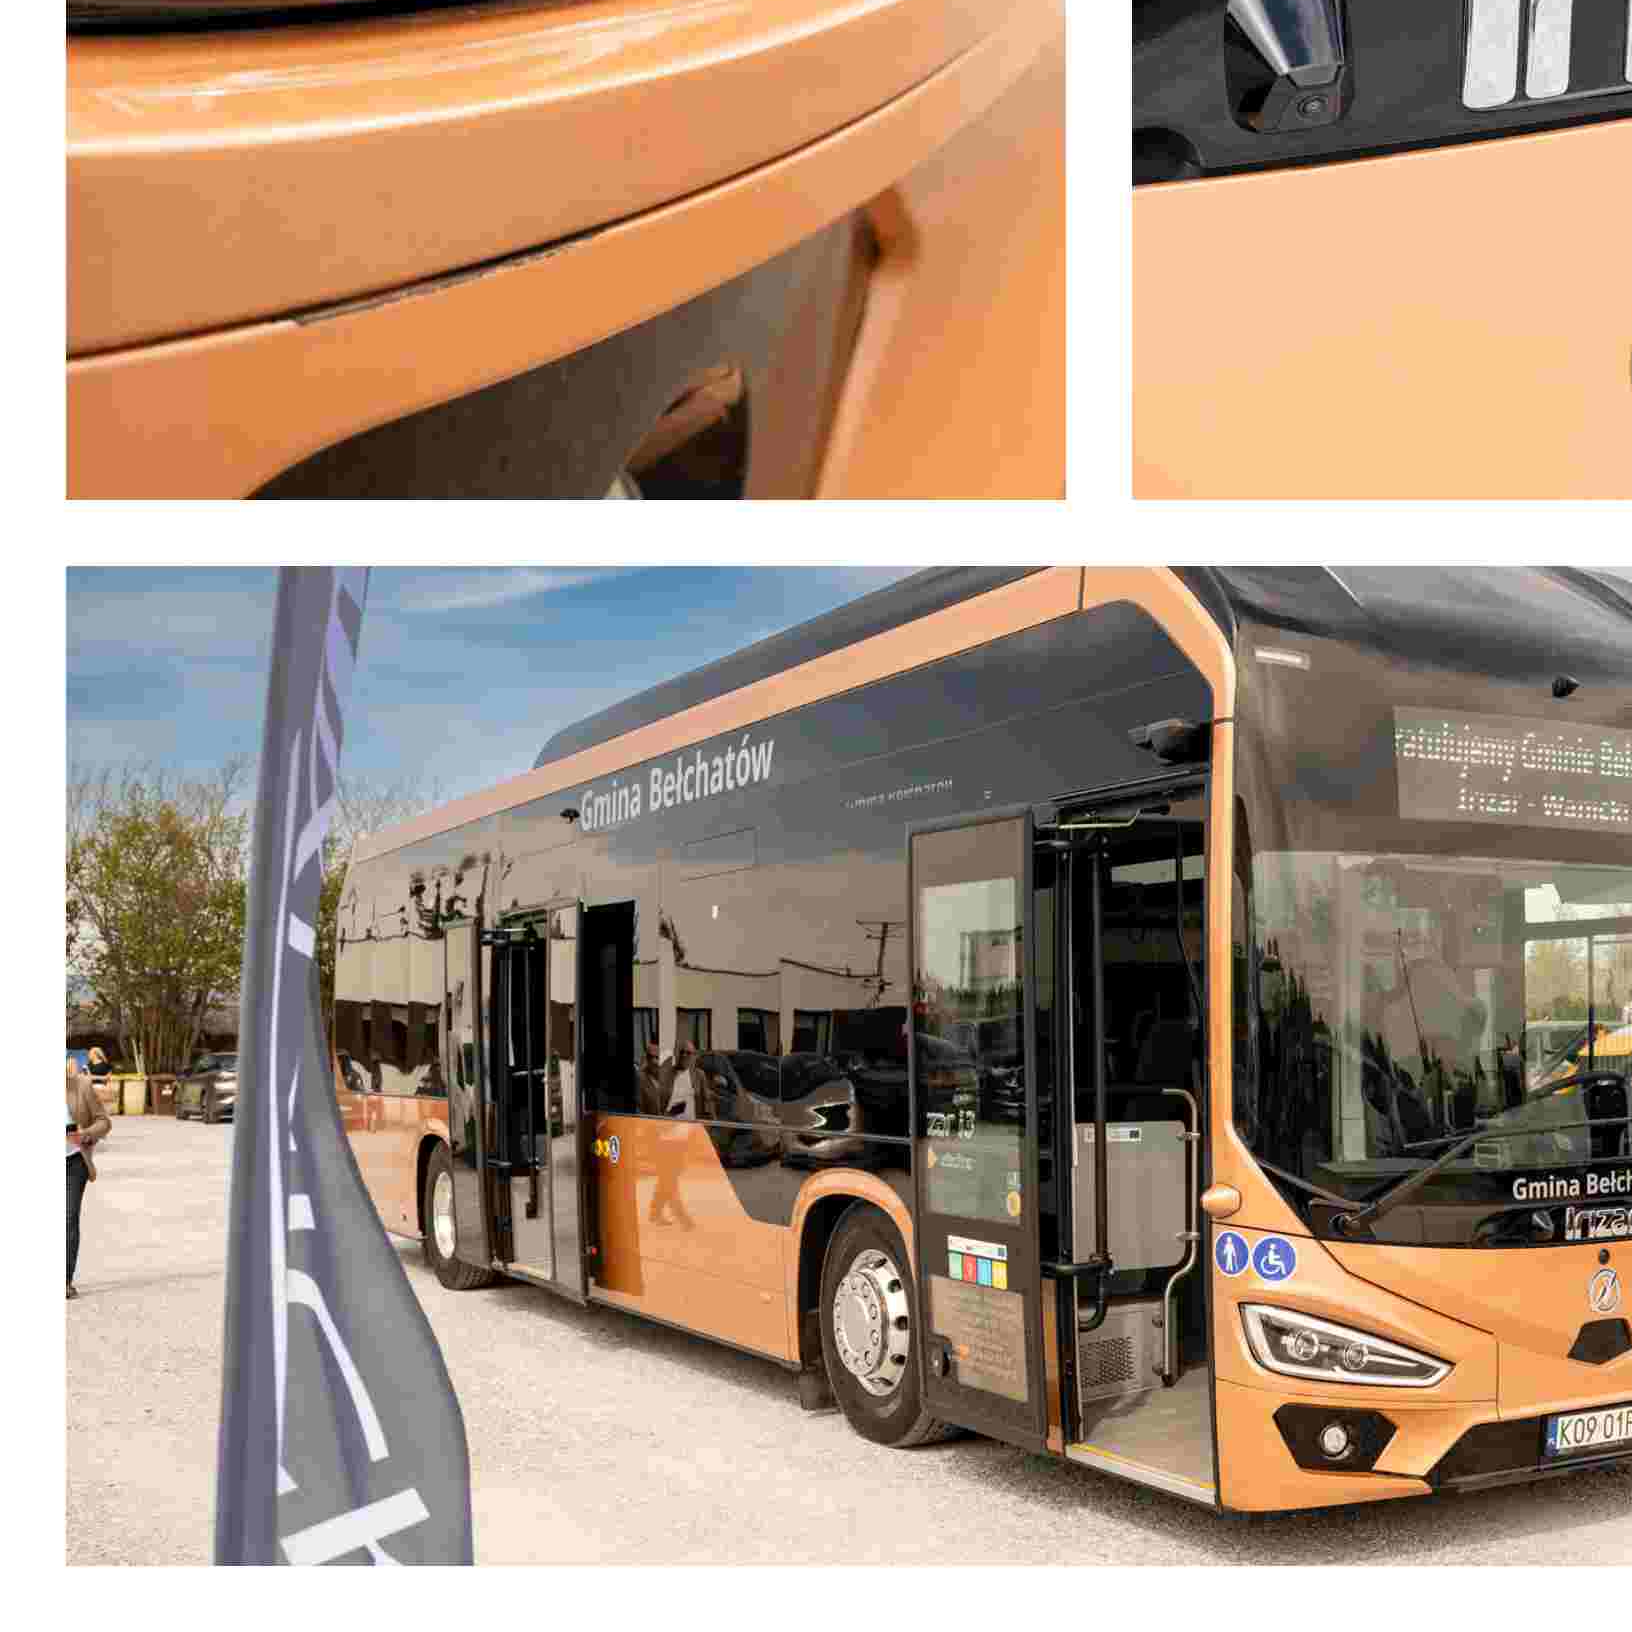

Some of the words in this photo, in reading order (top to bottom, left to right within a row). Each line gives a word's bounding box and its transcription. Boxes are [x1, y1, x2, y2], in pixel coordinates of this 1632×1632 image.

[581, 778, 641, 831] Gmina
[650, 733, 775, 811] Bełchatów
[1512, 1174, 1580, 1200] Gmina
[1560, 1417, 1598, 1445] K09
